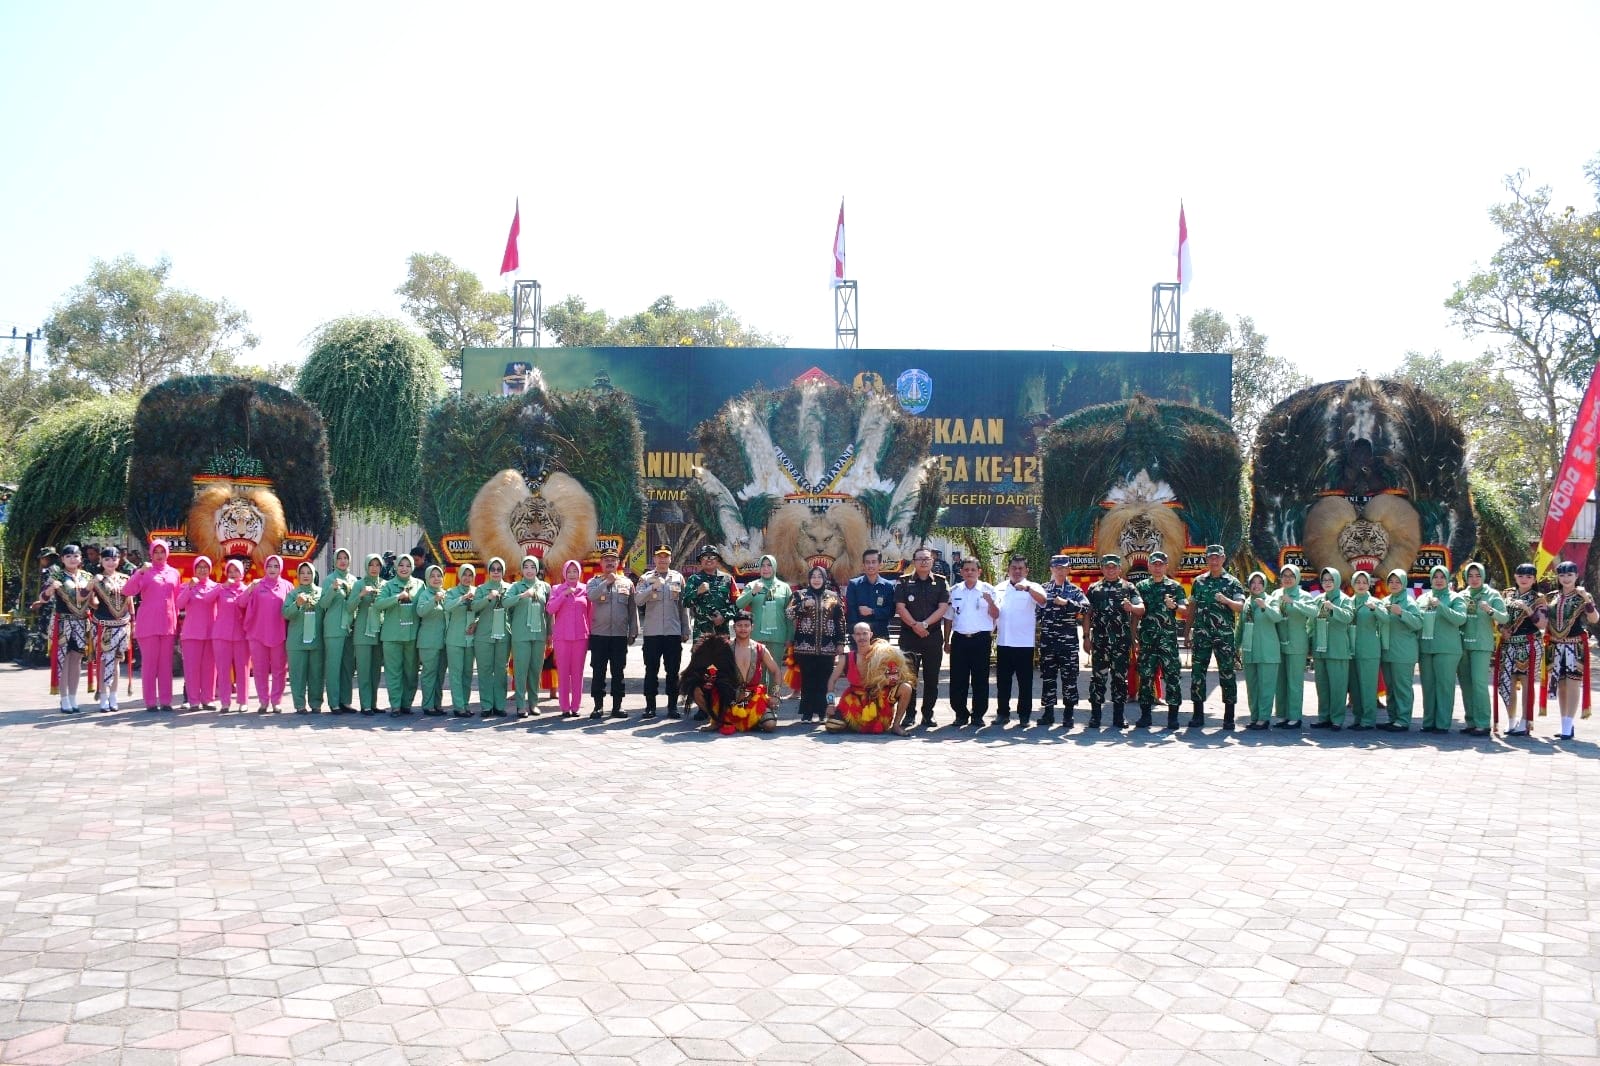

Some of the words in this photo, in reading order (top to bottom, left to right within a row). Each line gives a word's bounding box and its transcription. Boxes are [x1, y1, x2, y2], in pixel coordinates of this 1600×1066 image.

[778, 450, 801, 482] KOREA
[827, 450, 850, 481] JAPAN
[995, 494, 1030, 505] DARI
